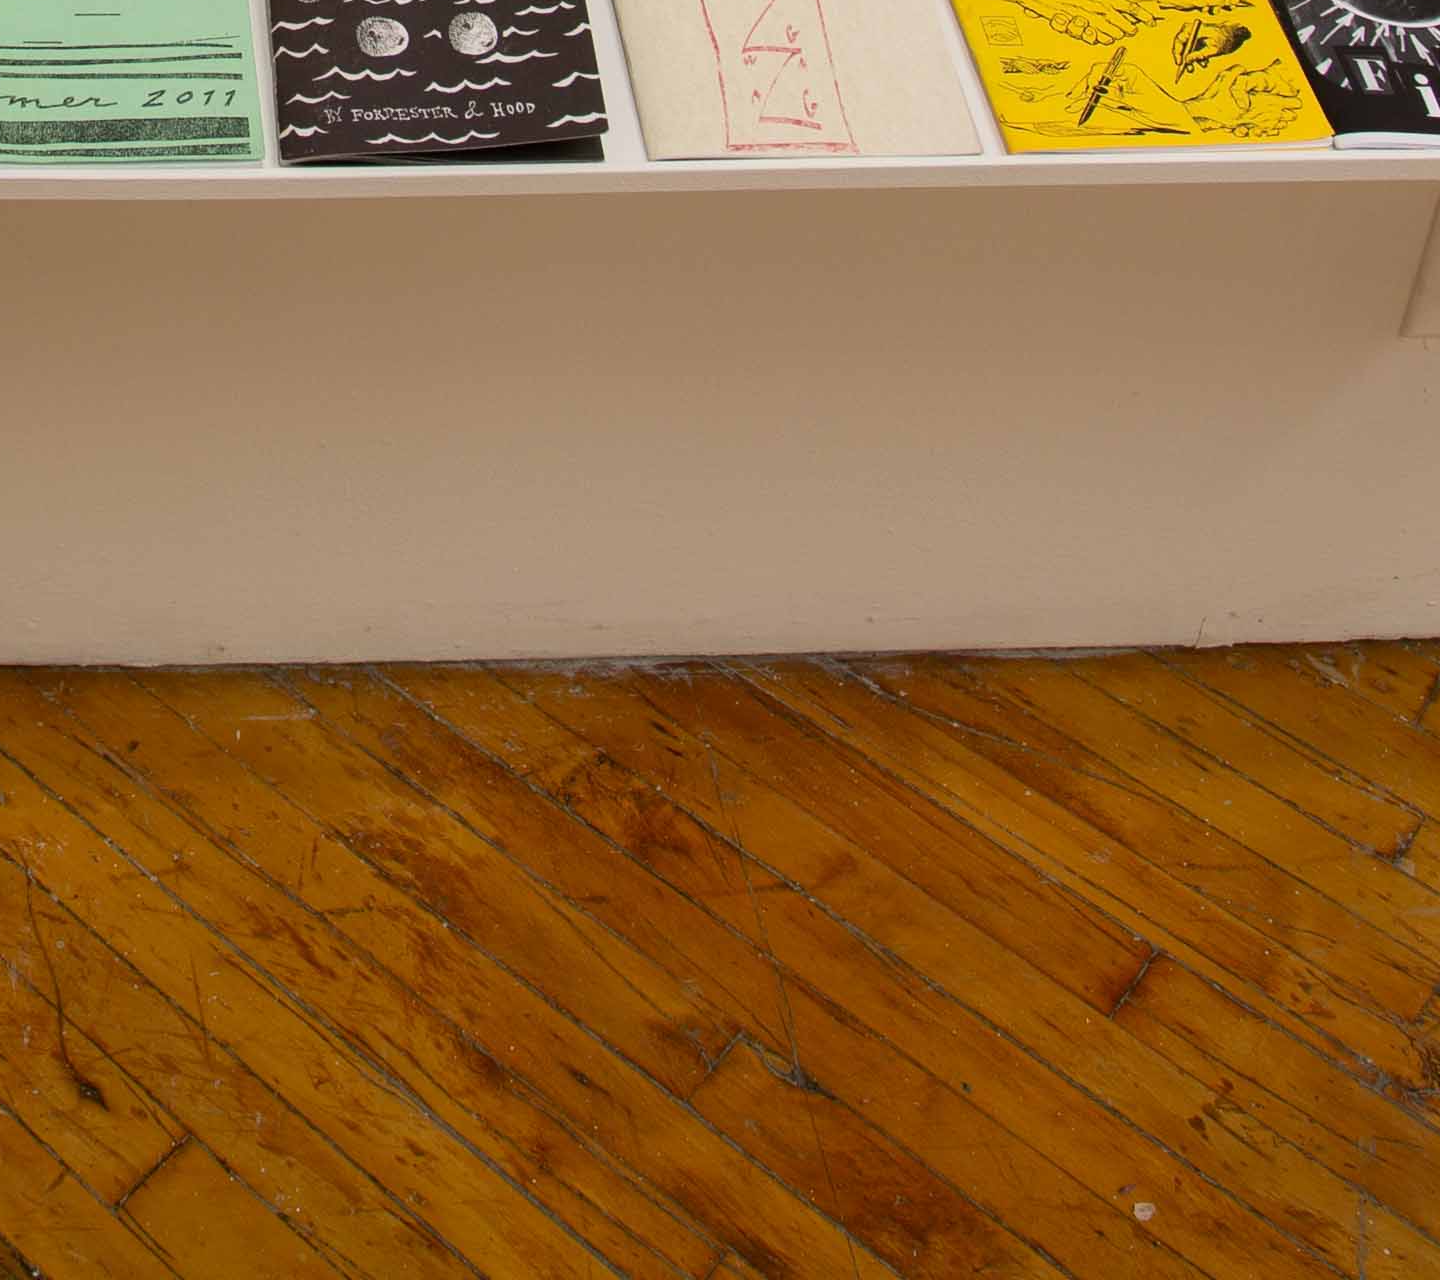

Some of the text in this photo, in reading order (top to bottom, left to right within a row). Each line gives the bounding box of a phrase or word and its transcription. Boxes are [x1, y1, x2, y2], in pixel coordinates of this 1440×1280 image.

[141, 89, 239, 109] 2011
[323, 100, 537, 125] BY FORRESTER & HOOD
